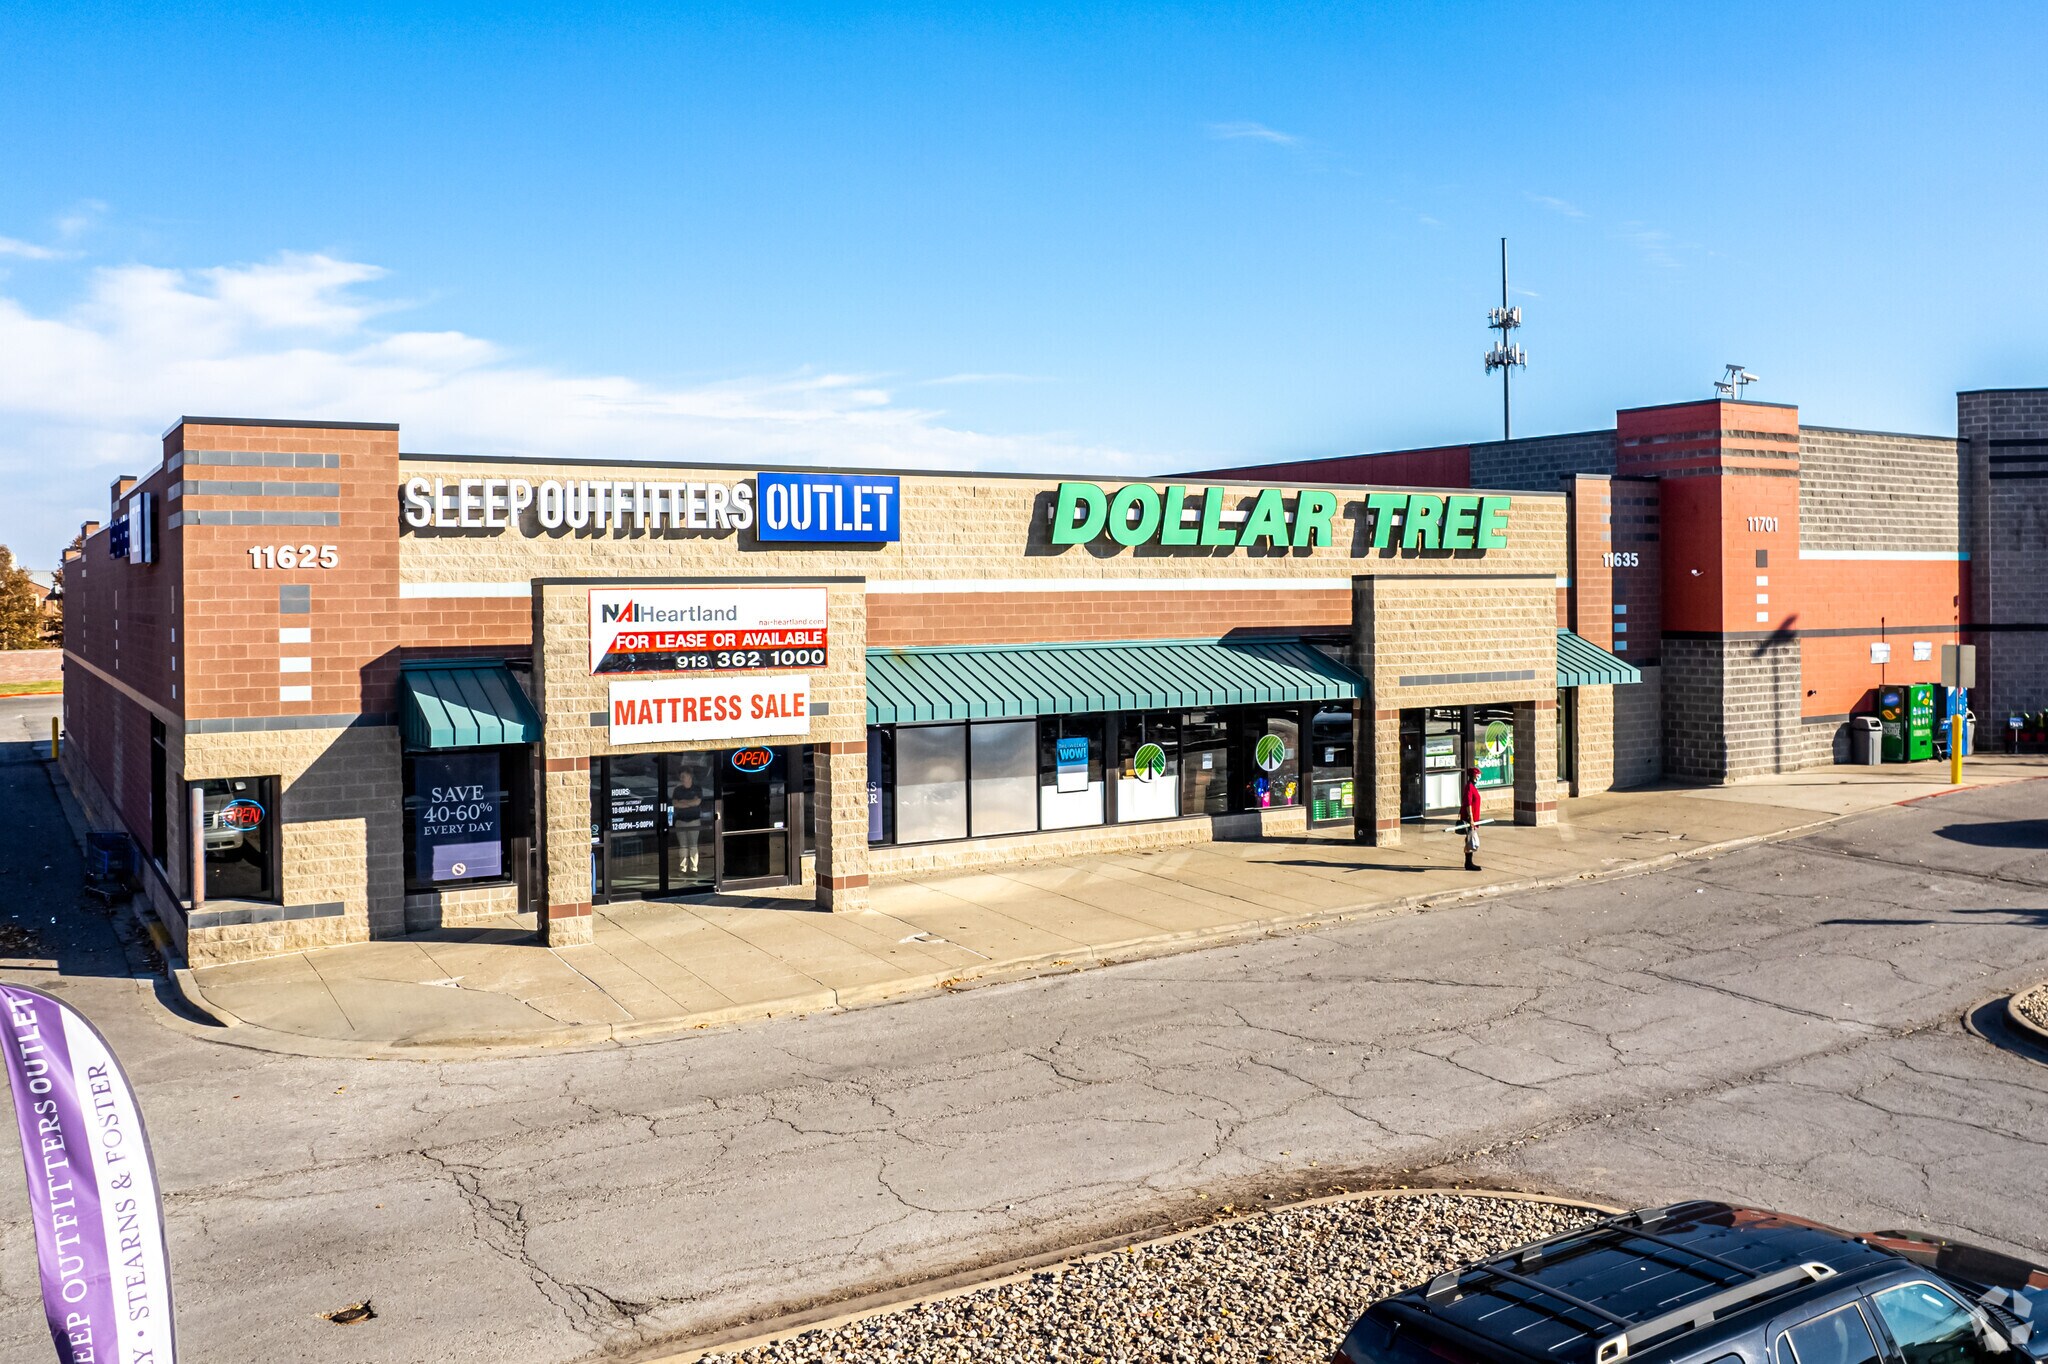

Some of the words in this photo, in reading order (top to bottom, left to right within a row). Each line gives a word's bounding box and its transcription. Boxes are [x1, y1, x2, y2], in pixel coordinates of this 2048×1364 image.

[405, 477, 532, 527] SLEEP
[538, 479, 753, 530] OUTFITTERS
[766, 483, 894, 531] OUTLET
[1051, 482, 1338, 547] DOLLAR
[1366, 493, 1511, 550] TREE
[1747, 516, 1778, 532] 11701
[247, 544, 339, 569] 11625
[1602, 552, 1639, 568] 11635
[758, 618, 825, 626] nai-heartland.com
[616, 635, 649, 650] FOR
[655, 633, 707, 648] LEASE
[712, 633, 736, 647] OR
[741, 631, 822, 646] AVAILABLE
[677, 656, 708, 669] 913
[716, 651, 760, 667] 362
[770, 649, 824, 666] 1000
[614, 694, 742, 726] MATTRESS
[750, 692, 805, 719] SALE
[734, 752, 769, 765] OPEN
[1060, 748, 1087, 760] WOW!
[431, 785, 484, 803] SAVE
[224, 806, 261, 823] OPEN
[423, 802, 493, 823] 40-60%
[424, 824, 465, 836] EVERY
[469, 822, 494, 832] DAY
[8, 996, 52, 1094] OUTLET
[88, 1061, 126, 1166] FOSTER
[111, 1171, 133, 1190] &
[34, 1099, 88, 1303] OUTFITTERS
[115, 1198, 150, 1321] STEARNS
